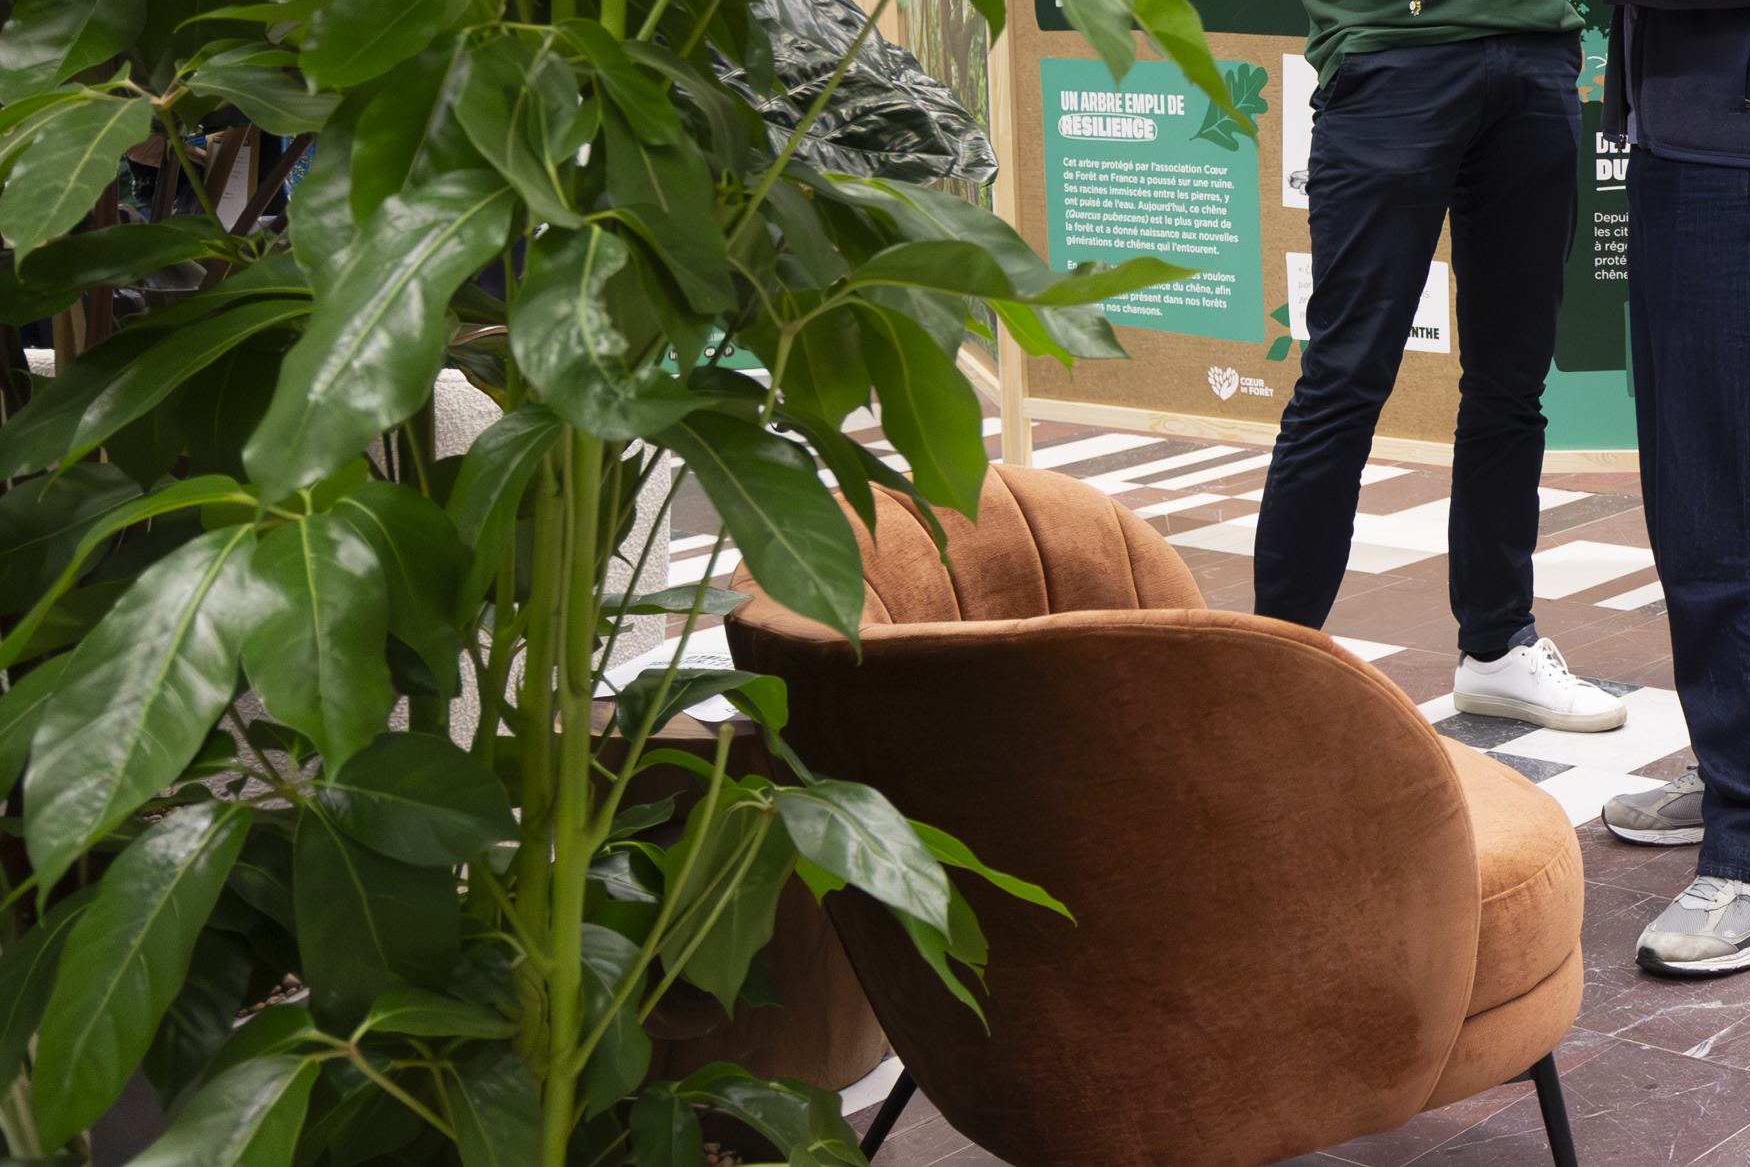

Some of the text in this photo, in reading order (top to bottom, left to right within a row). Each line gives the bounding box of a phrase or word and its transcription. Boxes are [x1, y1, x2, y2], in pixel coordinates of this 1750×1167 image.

[1061, 91, 1185, 115] UN ARBRE EMPLI DE
[1063, 157, 1228, 175] Cet arbre protégé par l'association Cœur
[1594, 226, 1610, 237] les
[1172, 282, 1231, 295] du chêne, afin
[1130, 293, 1161, 303] présent
[1163, 295, 1184, 305] dans
[1185, 297, 1200, 306] nos
[1202, 297, 1227, 309] forêts
[1411, 326, 1440, 340] NTHE
[1240, 377, 1264, 387] CŒUR
[1249, 387, 1274, 397] FORÊT
